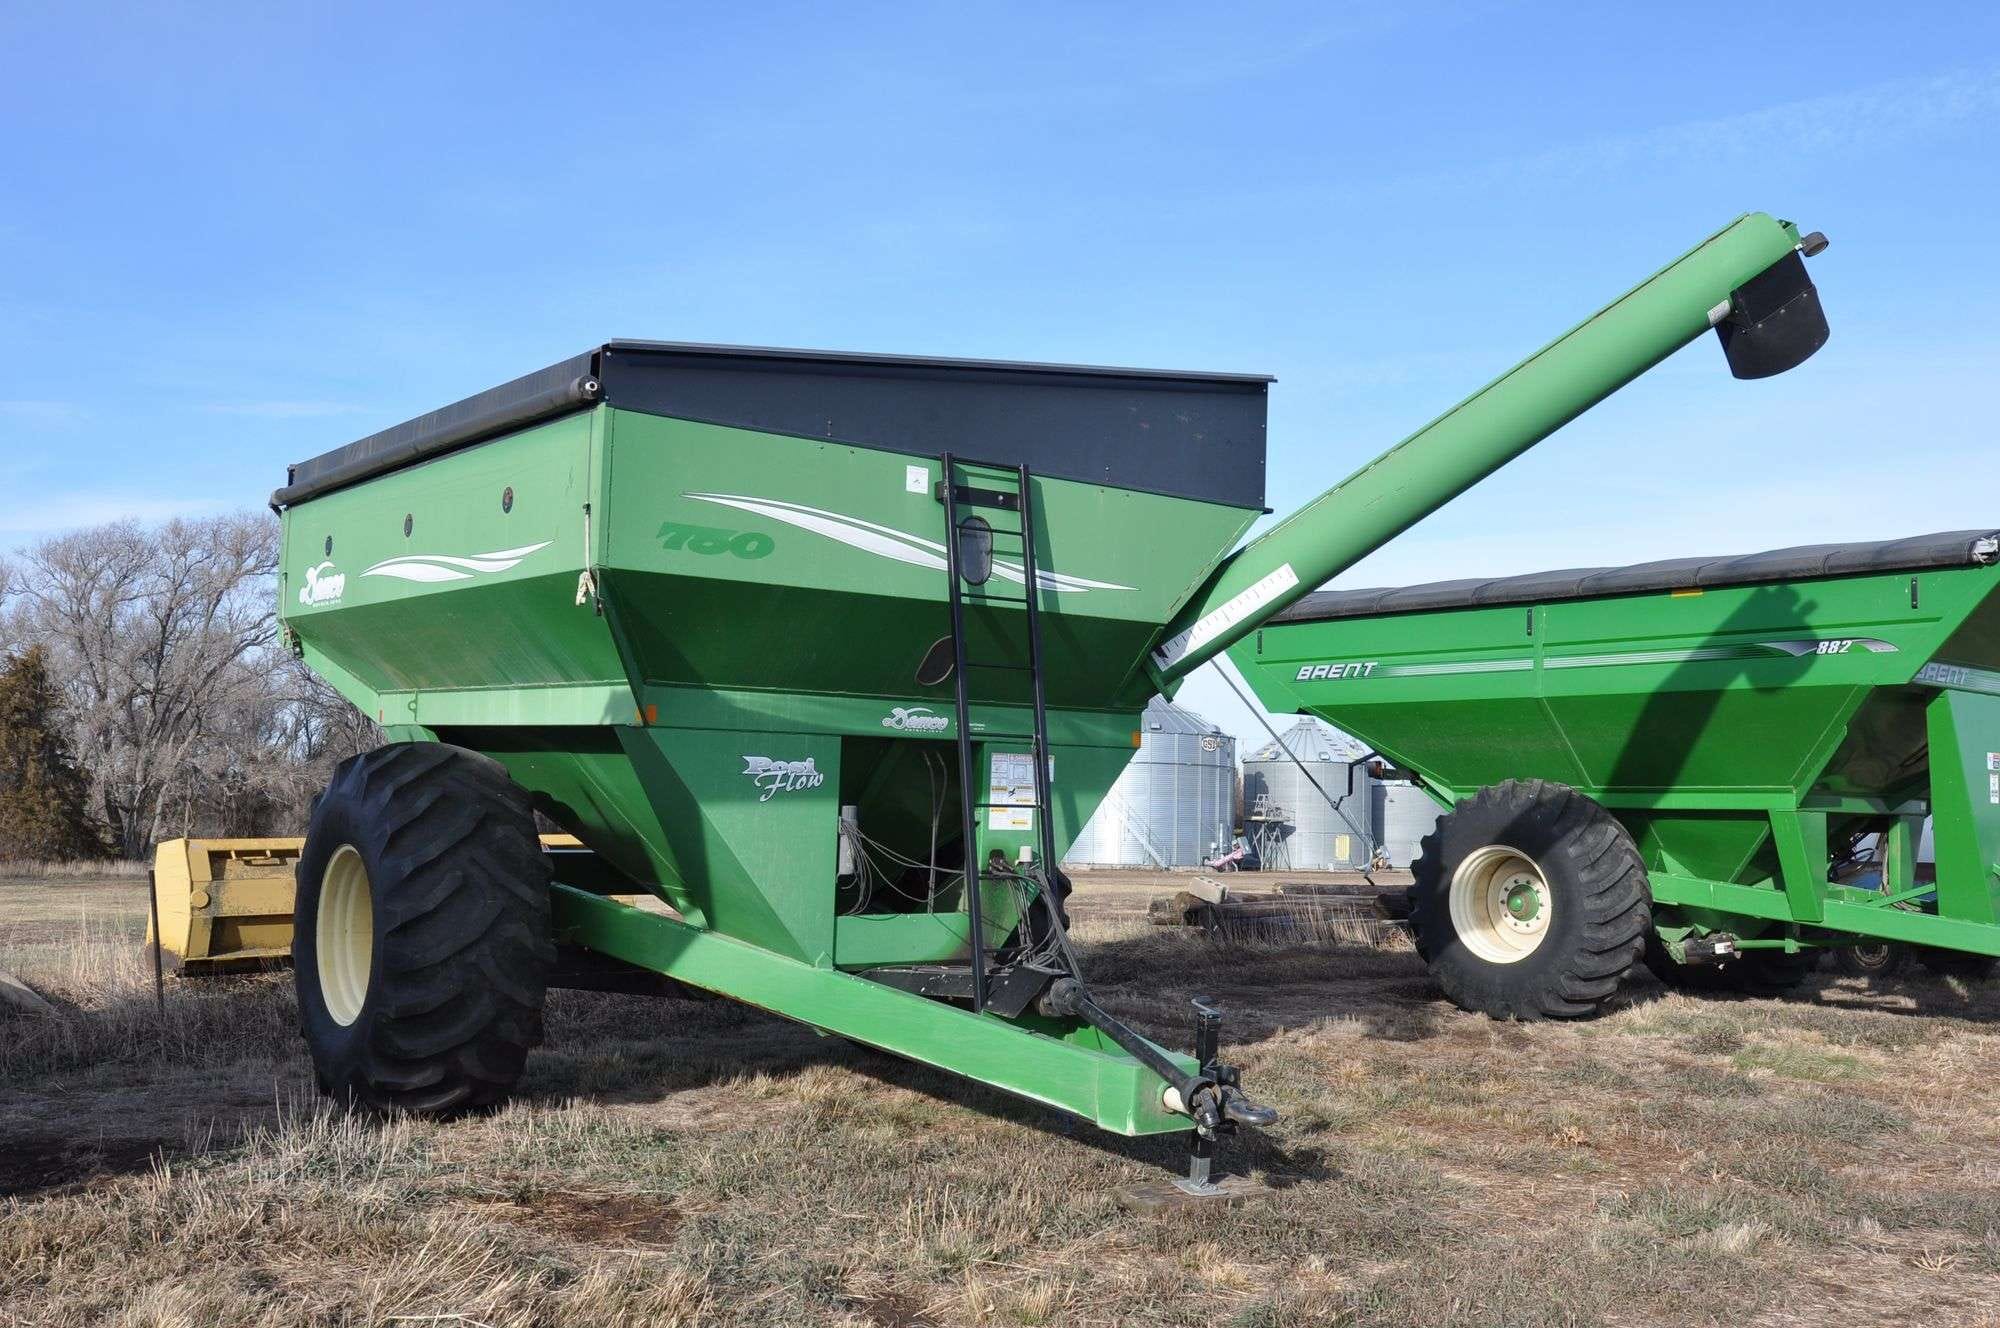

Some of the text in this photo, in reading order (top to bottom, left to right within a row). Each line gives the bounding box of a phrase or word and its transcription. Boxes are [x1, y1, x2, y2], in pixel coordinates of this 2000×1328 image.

[1816, 640, 1853, 655] 882
[1296, 661, 1378, 681] BRENT
[881, 707, 949, 731] Demco
[742, 755, 819, 776] Posi
[754, 770, 824, 802] Flow
